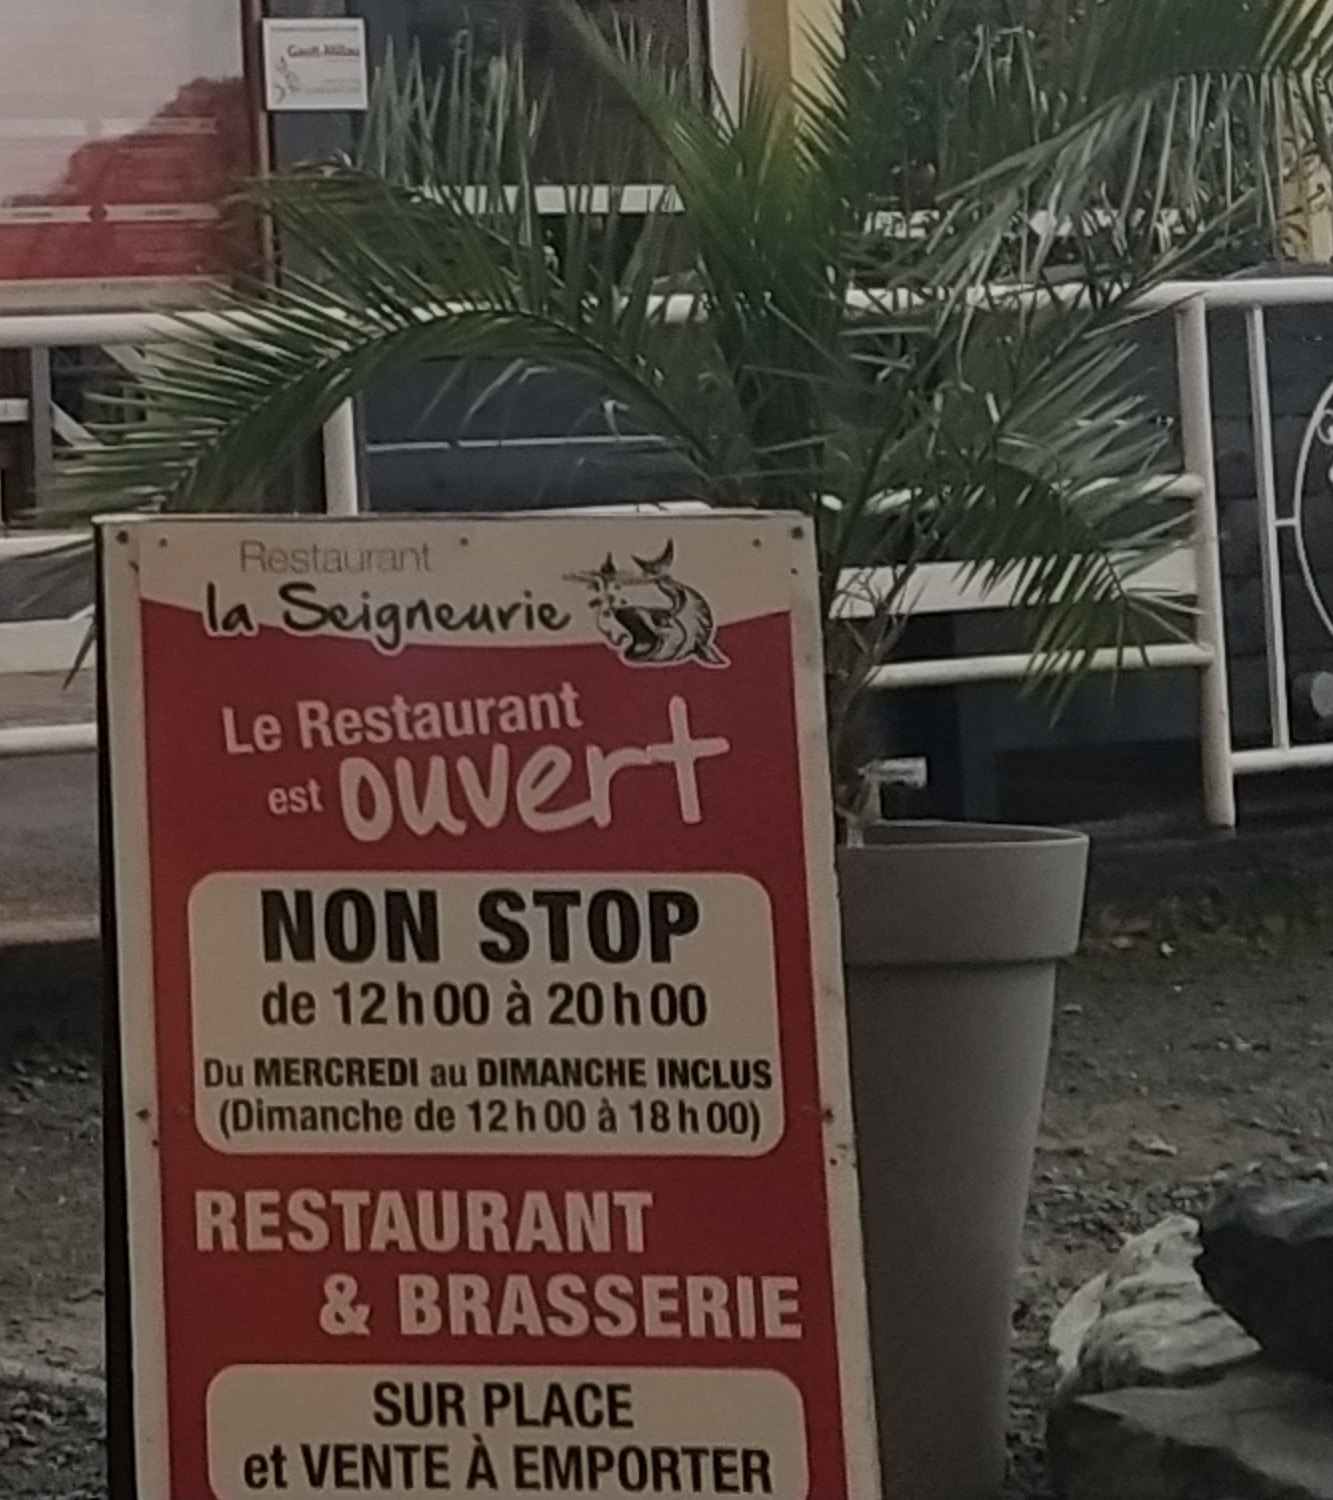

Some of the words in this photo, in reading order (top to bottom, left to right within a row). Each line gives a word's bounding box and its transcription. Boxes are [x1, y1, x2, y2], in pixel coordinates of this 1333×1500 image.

[239, 540, 434, 573] Restaurant
[205, 582, 252, 633] la
[279, 582, 572, 649] Seigneurie
[222, 706, 281, 754] Le
[298, 681, 584, 750] Restaurant
[268, 779, 323, 815] est
[339, 696, 730, 842] ouvert
[260, 888, 441, 963] NON
[478, 888, 701, 964] STOP
[262, 982, 316, 1026] de
[505, 979, 533, 1027] à
[203, 1058, 244, 1089] Du
[254, 1056, 419, 1088] MERCREDI
[429, 1063, 468, 1088] au
[478, 1057, 647, 1089] DIMANCHE
[657, 1058, 772, 1090] INCLUS
[218, 1098, 402, 1142] (Dimanche
[414, 1099, 455, 1132] de
[598, 1099, 618, 1133] à
[193, 1188, 654, 1253] RESTAURANT
[319, 1272, 371, 1336] &
[398, 1274, 803, 1339] BRASSERIE
[373, 1381, 466, 1428] SUR
[484, 1381, 633, 1429] PLACE
[243, 1444, 287, 1490] et
[300, 1443, 451, 1490] VENTE
[465, 1434, 498, 1490] À
[515, 1444, 773, 1494] EMPORTER
